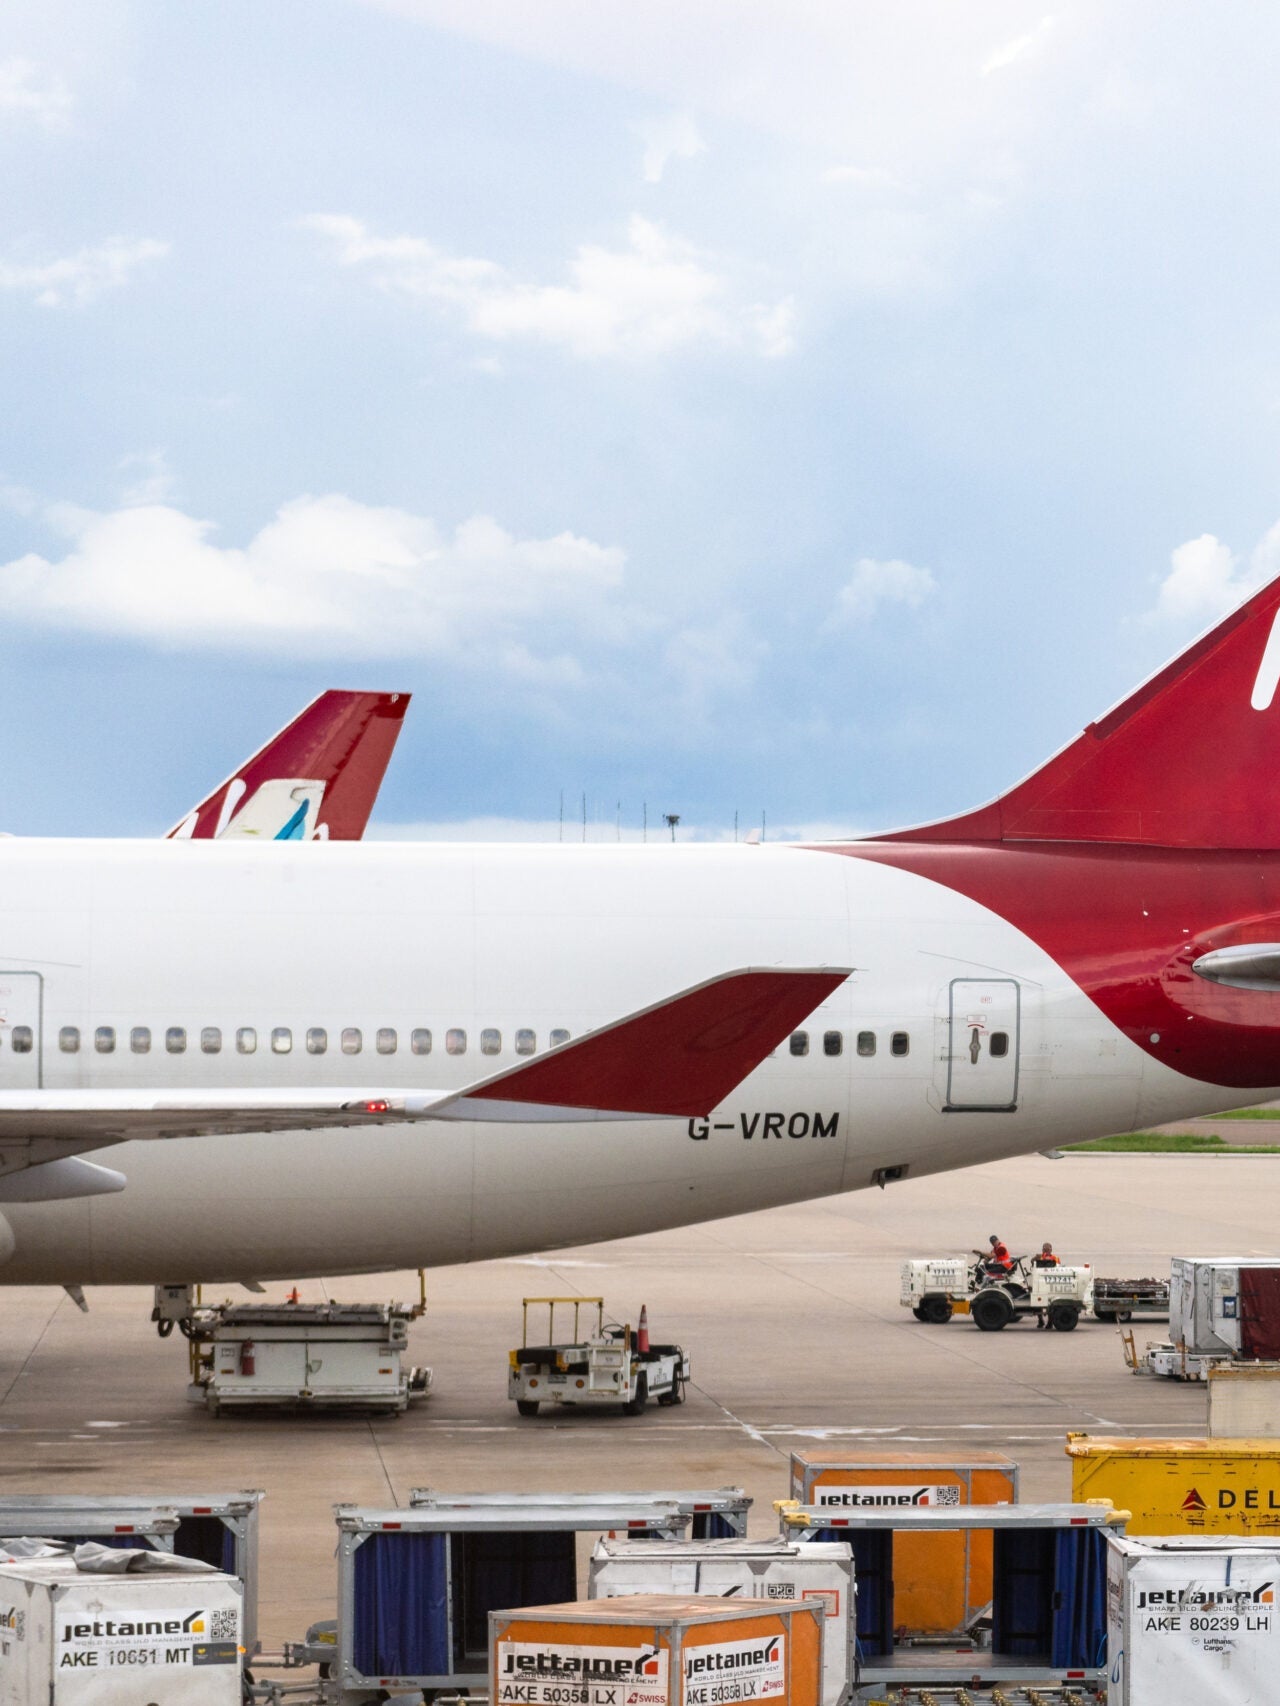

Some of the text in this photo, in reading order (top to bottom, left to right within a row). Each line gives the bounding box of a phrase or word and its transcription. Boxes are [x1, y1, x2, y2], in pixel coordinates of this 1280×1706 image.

[688, 1111, 840, 1140] G-VROM
[61, 1610, 205, 1642] jettainer
[1145, 1616, 1269, 1631] AKE 80239 LH
[60, 1648, 190, 1668] AKE 10651 MT
[503, 1650, 661, 1676] jettainer
[686, 1637, 780, 1679] jettainer
[503, 1685, 617, 1705] AKE 50358 LX
[686, 1681, 757, 1706] AKE 50358 LX
[768, 1680, 784, 1690] SWISS
[639, 1694, 666, 1703] SWISS
